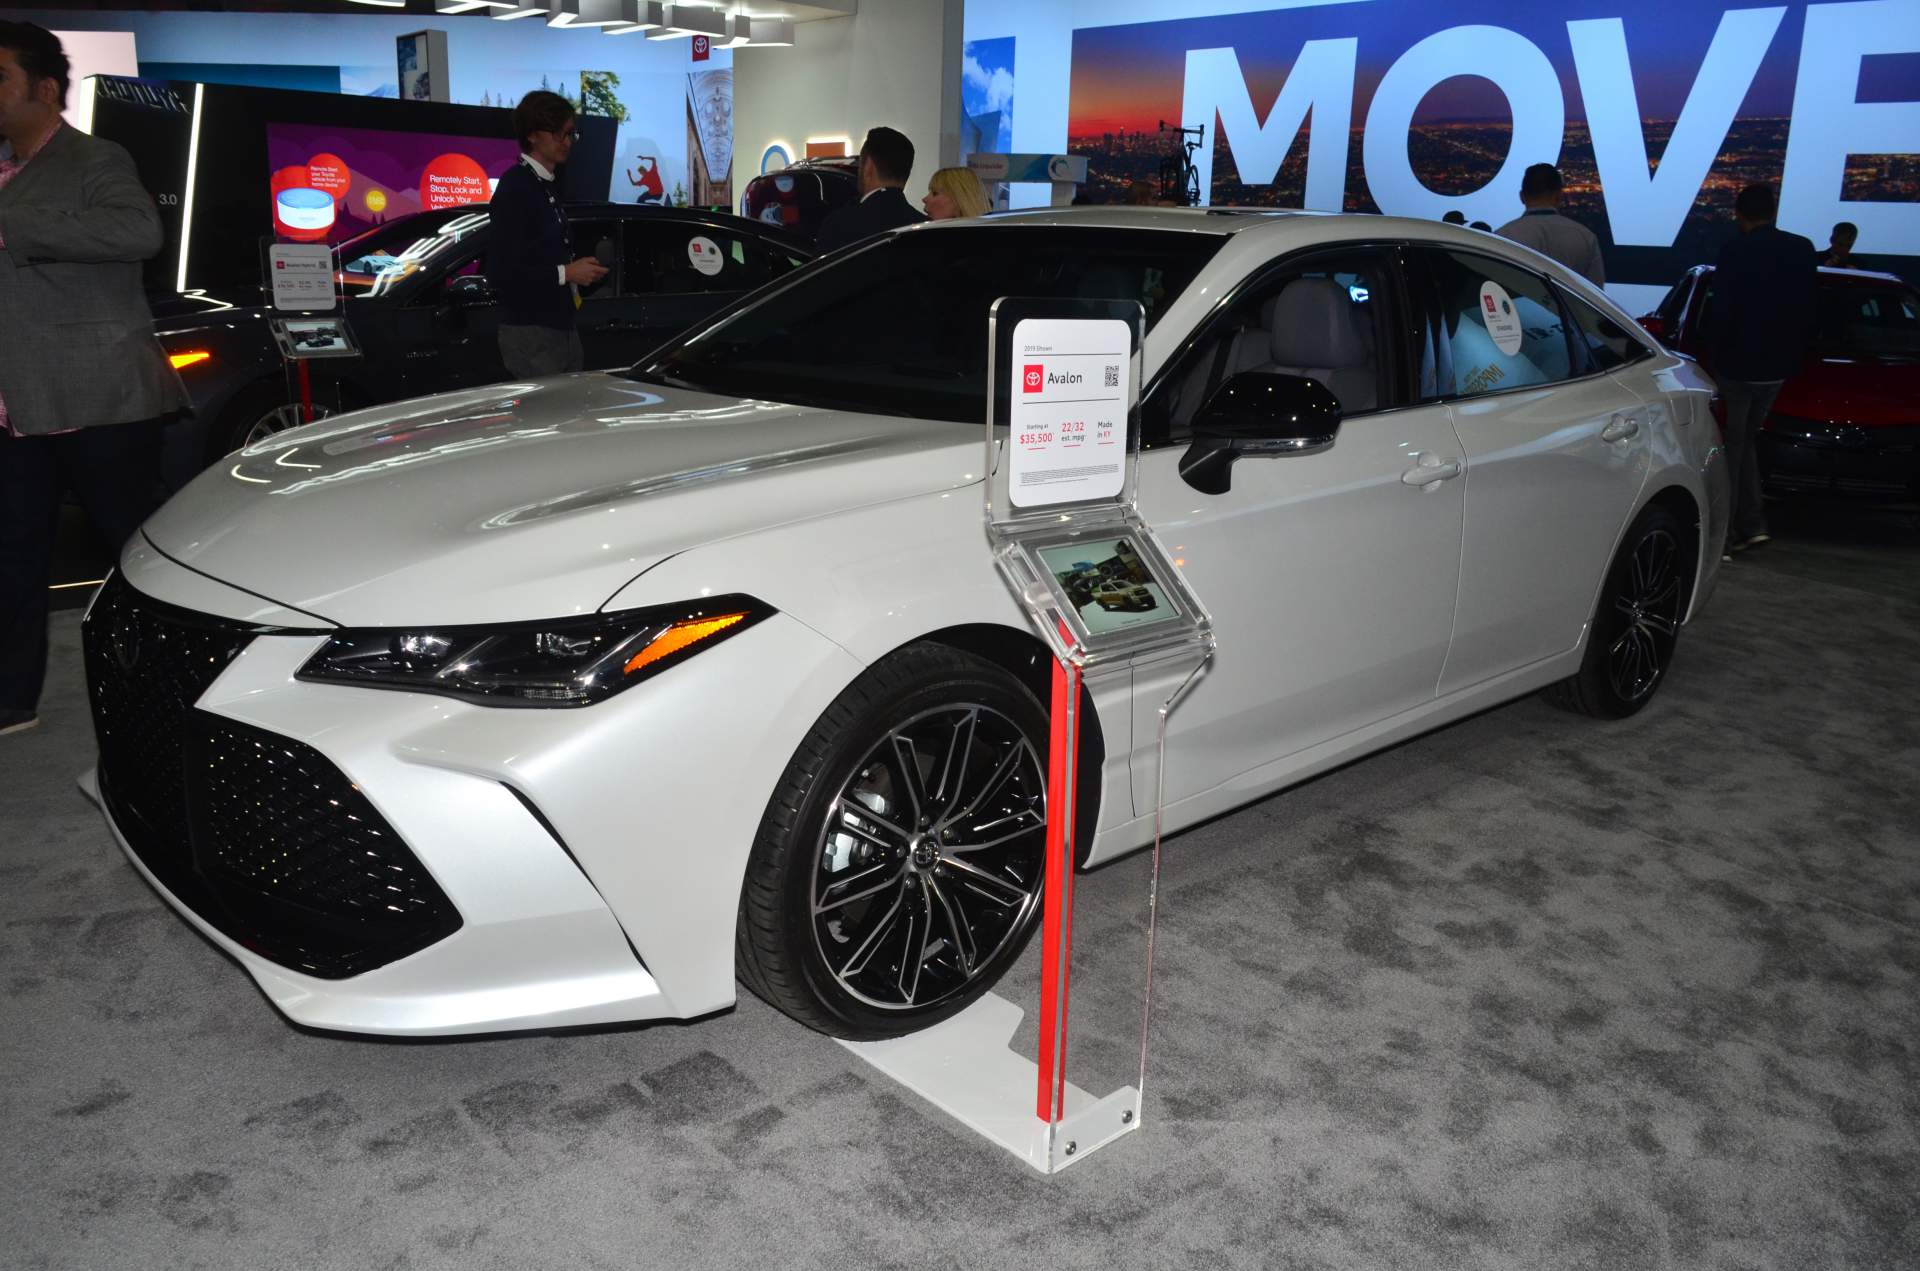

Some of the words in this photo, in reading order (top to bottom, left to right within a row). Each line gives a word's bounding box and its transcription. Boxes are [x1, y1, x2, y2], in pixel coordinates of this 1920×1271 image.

[1182, 0, 1920, 258] MOVE
[430, 175, 461, 185] Remotely
[463, 176, 482, 185] Start,
[451, 185, 467, 194] Lock
[159, 193, 177, 205] 3.0
[430, 195, 454, 203] Unlock
[1047, 371, 1083, 384] Avalon
[1061, 422, 1085, 432] 22/32
[1020, 433, 1053, 444] $35,500
